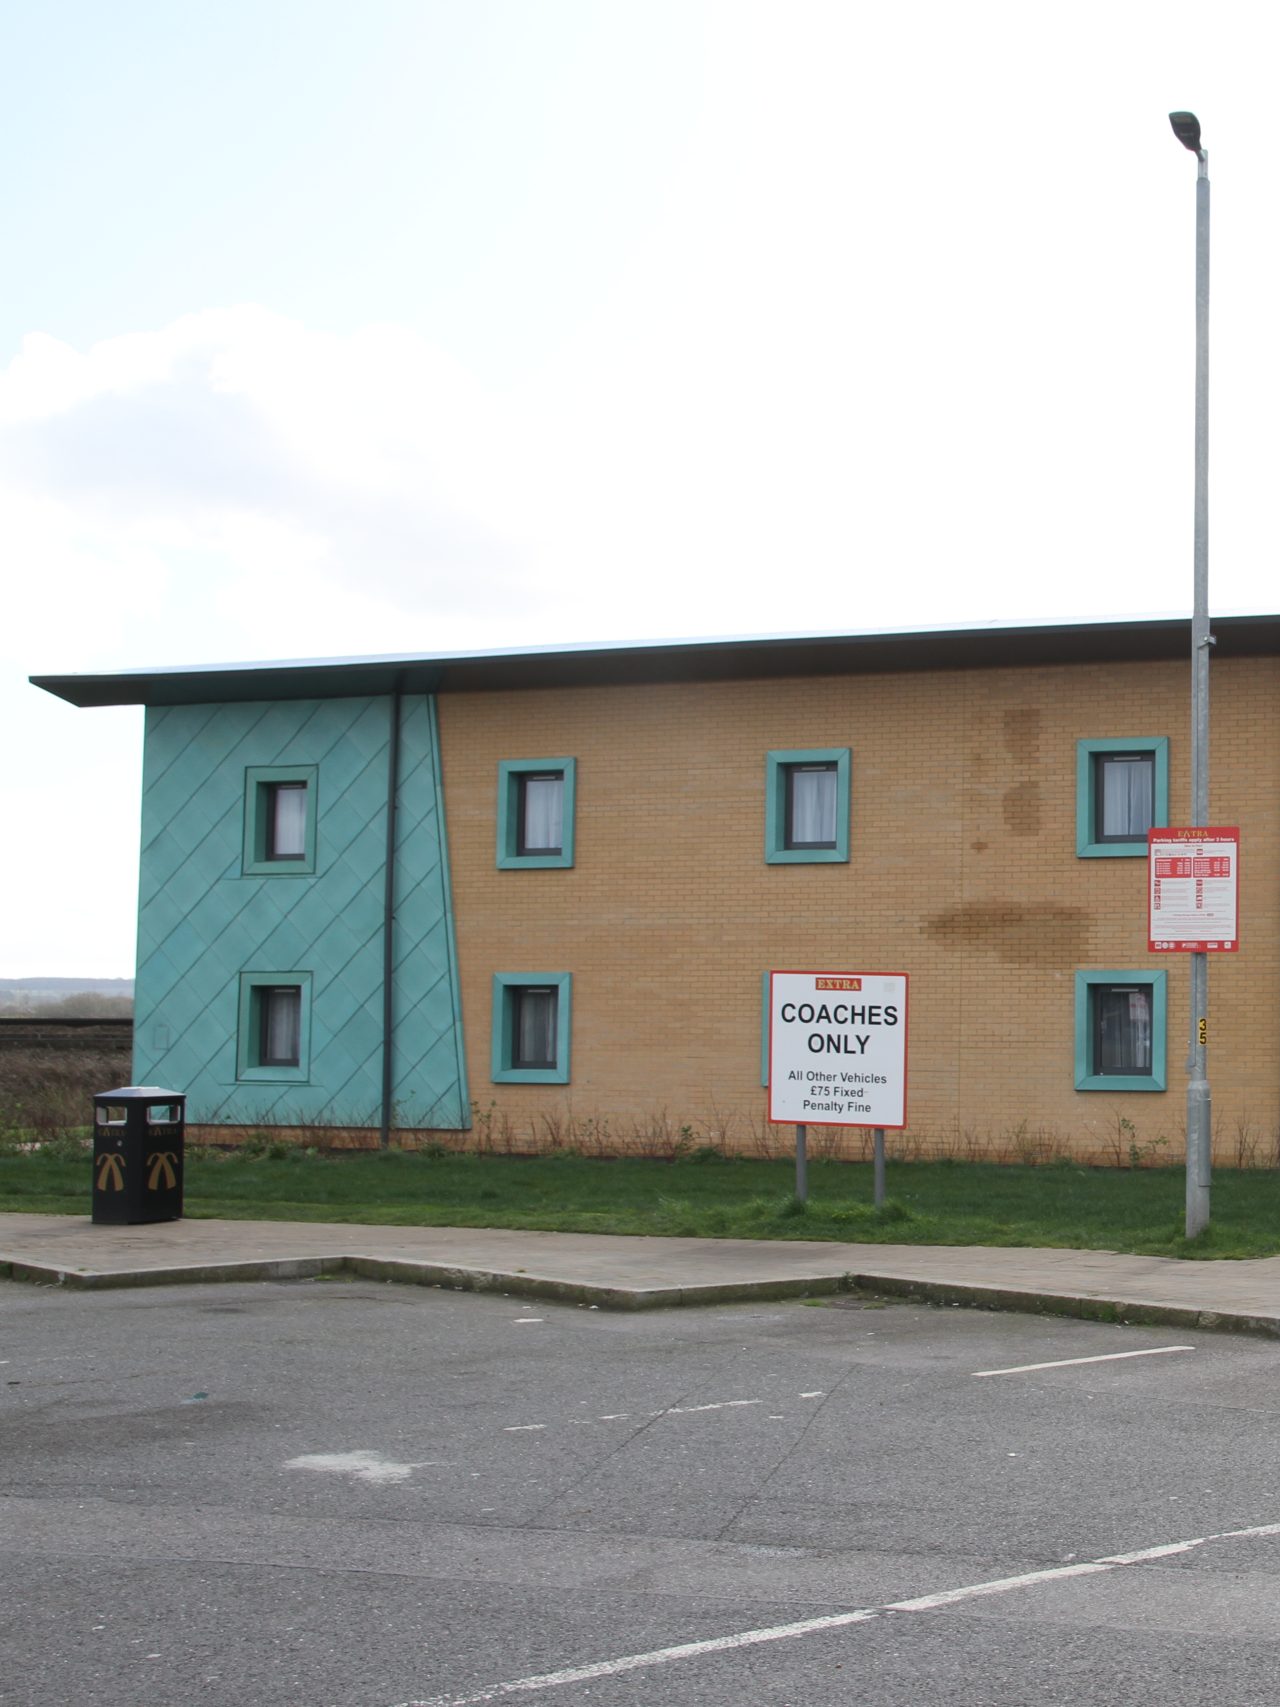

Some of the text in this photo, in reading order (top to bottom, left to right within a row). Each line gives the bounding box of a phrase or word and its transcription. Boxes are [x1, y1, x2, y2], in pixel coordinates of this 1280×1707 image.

[817, 979, 860, 990] EXTRA
[781, 1002, 898, 1026] COACHES
[807, 1032, 870, 1055] ONLY
[788, 1070, 887, 1084] All Other Vehicles
[810, 1085, 864, 1098] £75 Fixed
[803, 1099, 872, 1114] Penalty Fine
